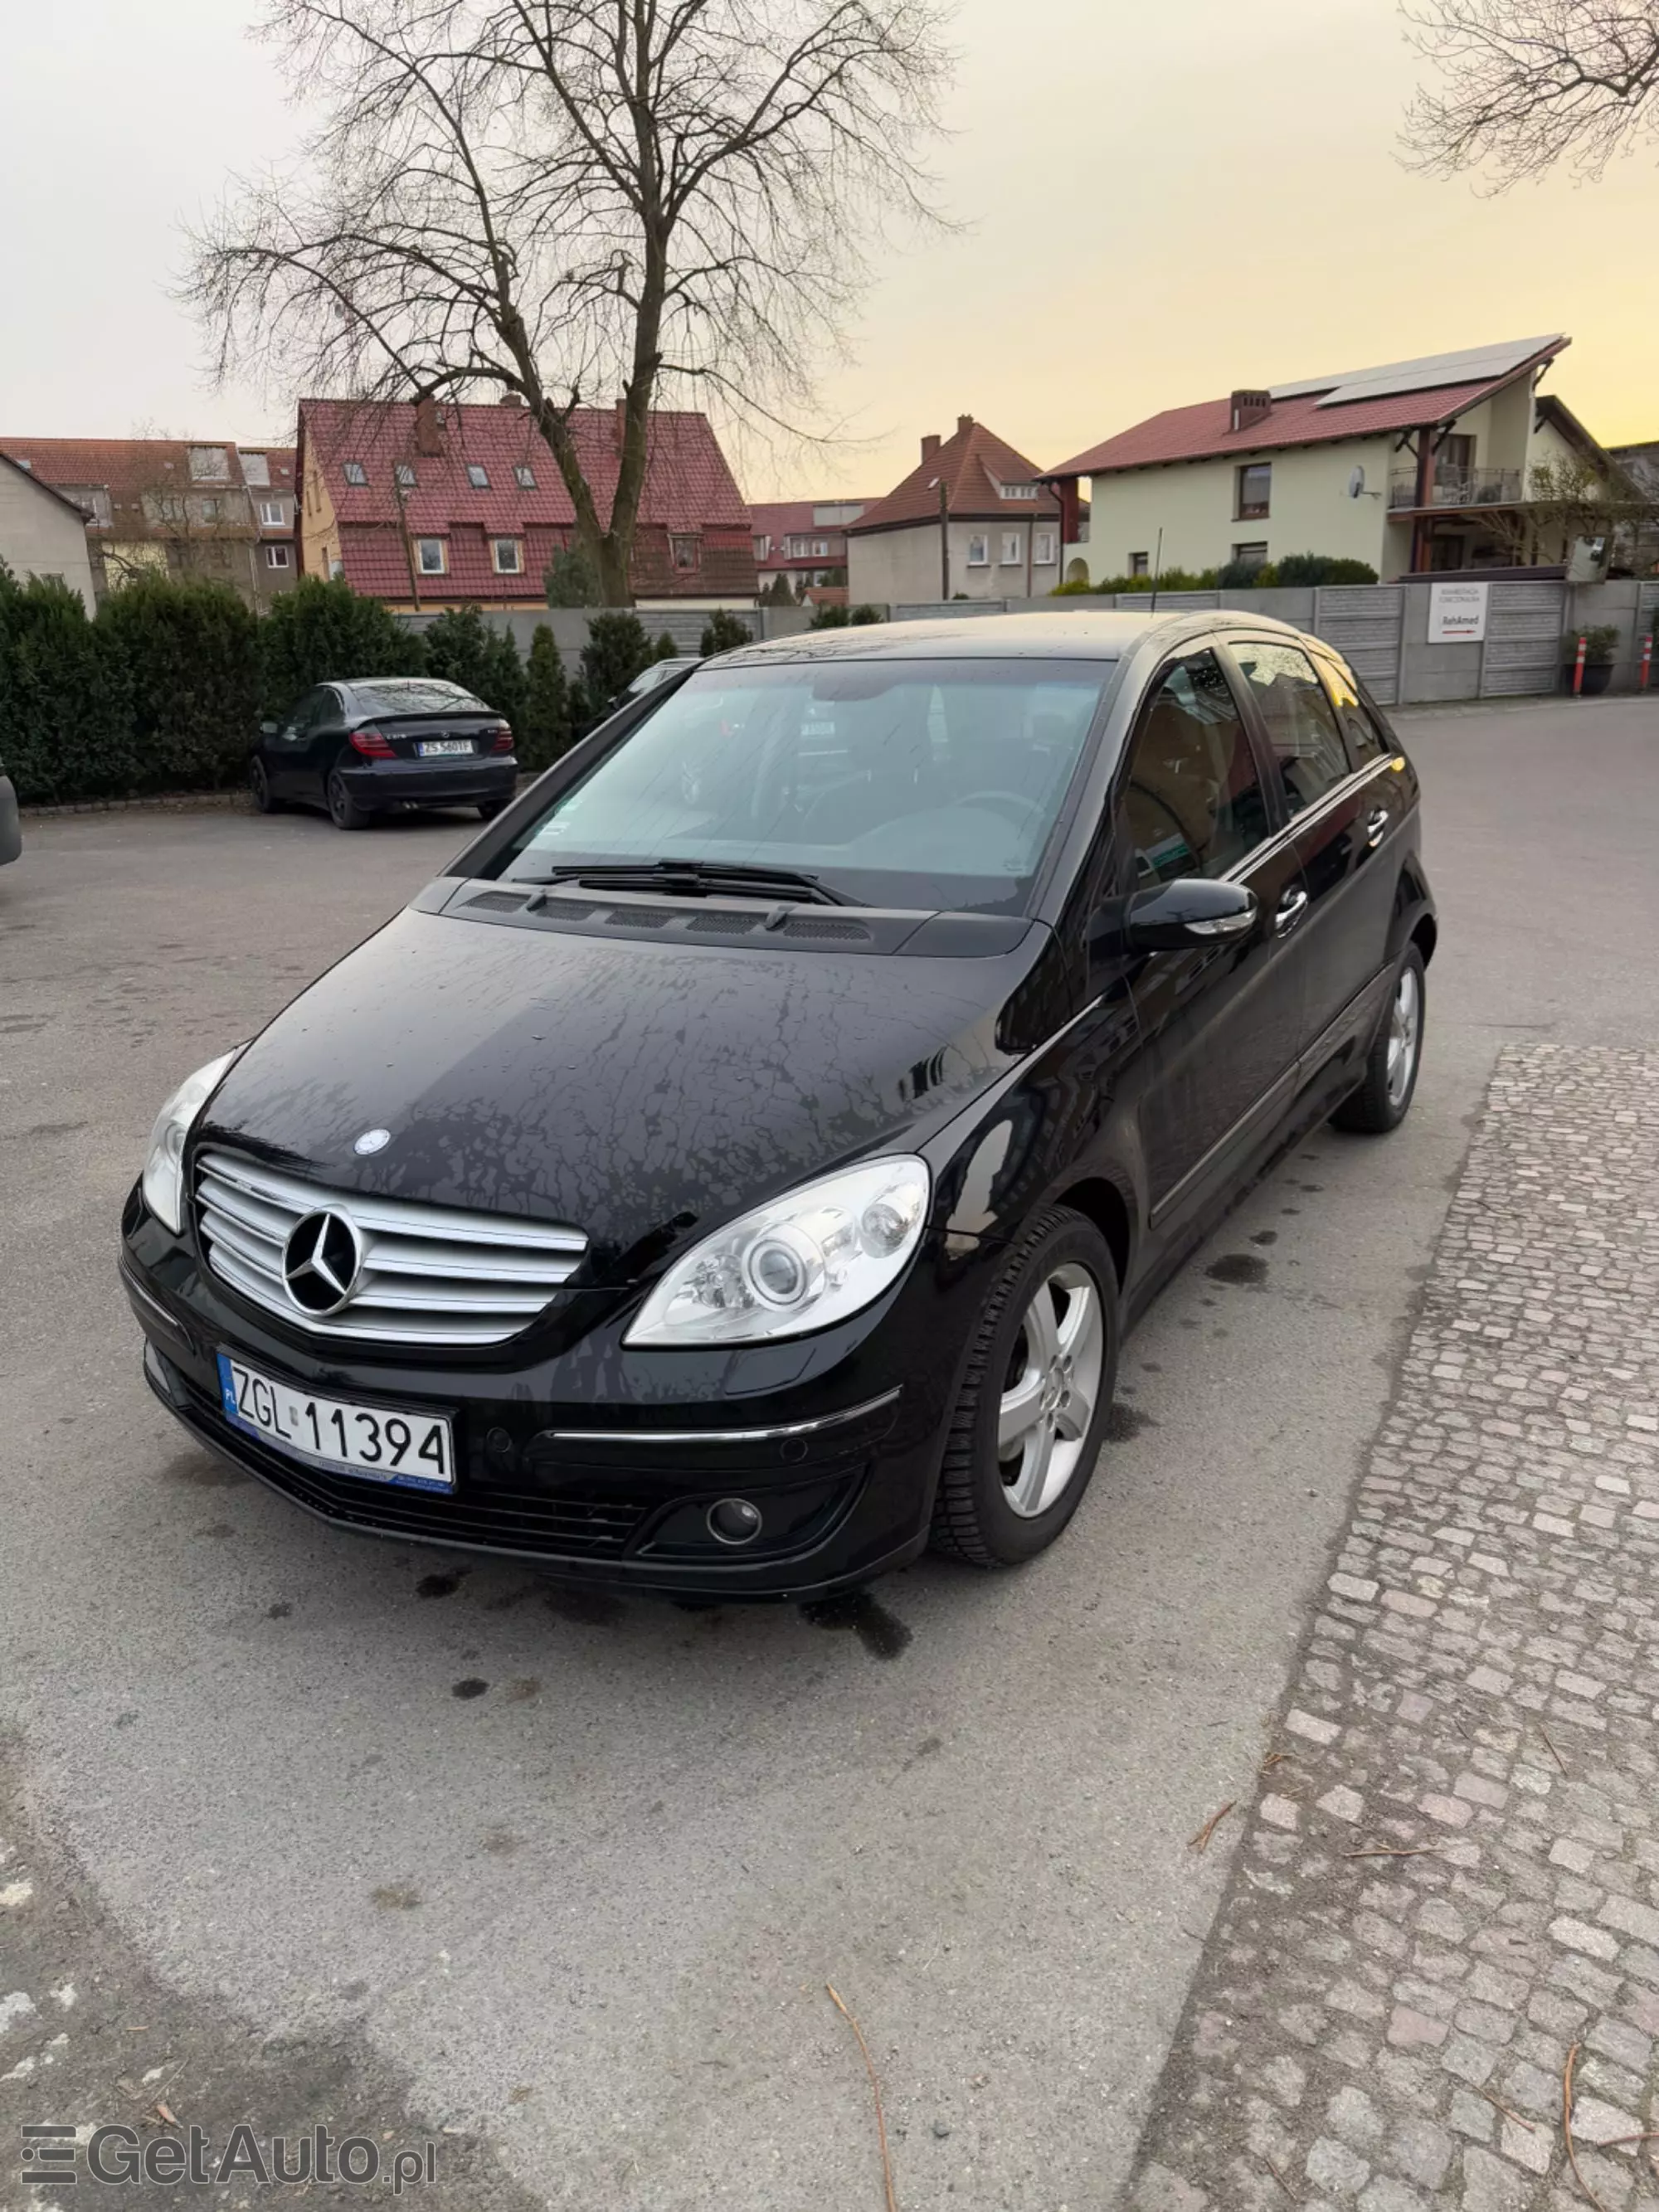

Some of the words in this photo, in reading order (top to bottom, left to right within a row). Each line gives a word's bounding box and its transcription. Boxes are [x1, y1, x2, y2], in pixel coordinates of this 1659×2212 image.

[225, 1388, 236, 1405] PL
[232, 1367, 292, 1440] ZGL
[305, 1402, 444, 1474] 11394
